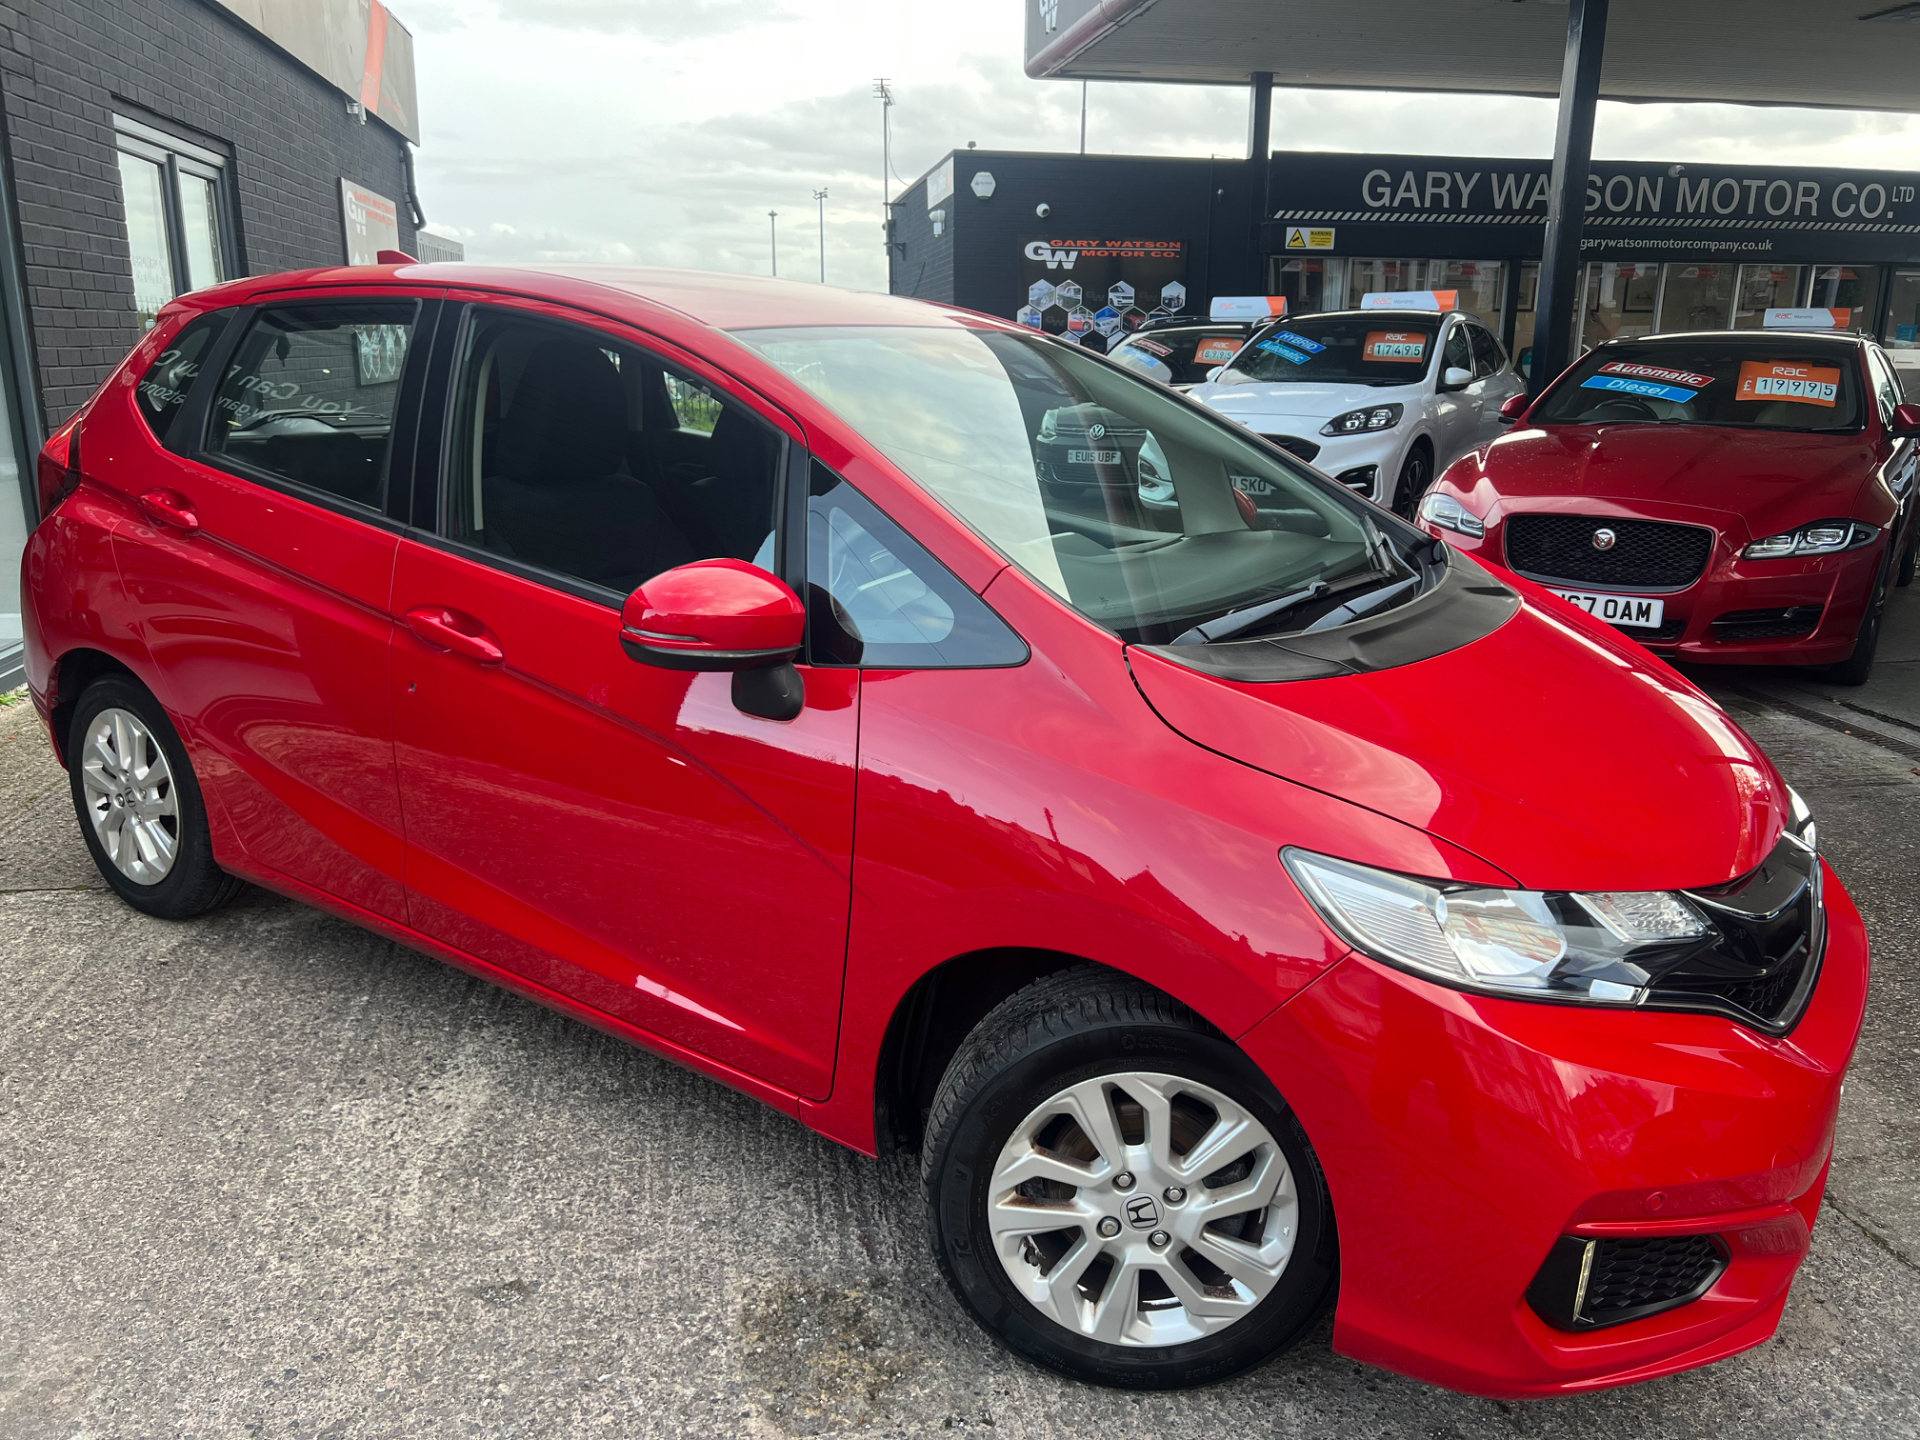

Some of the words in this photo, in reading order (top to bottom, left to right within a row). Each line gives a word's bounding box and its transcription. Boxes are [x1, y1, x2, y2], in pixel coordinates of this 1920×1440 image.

[1361, 168, 1482, 209] GARY
[1490, 172, 1664, 213] WASON
[1675, 176, 1822, 217] MOTOR
[1831, 182, 1894, 219] CO.
[1892, 185, 1915, 203] LTD
[1050, 239, 1100, 247] GARY
[1105, 240, 1181, 248] WATSON
[1580, 236, 1773, 252] garywatsonmotorcompany.co.uk
[1024, 241, 1079, 270] GW
[1261, 340, 1305, 363] Automatic
[1281, 332, 1320, 351] HYBRID
[1610, 362, 1703, 385] Automatic
[1605, 378, 1669, 397] Diesel
[1760, 377, 1836, 398] 19995
[1075, 451, 1095, 462] EU15
[1098, 451, 1117, 463] UBF
[1561, 593, 1597, 614] 67
[1603, 598, 1652, 623] OAM
